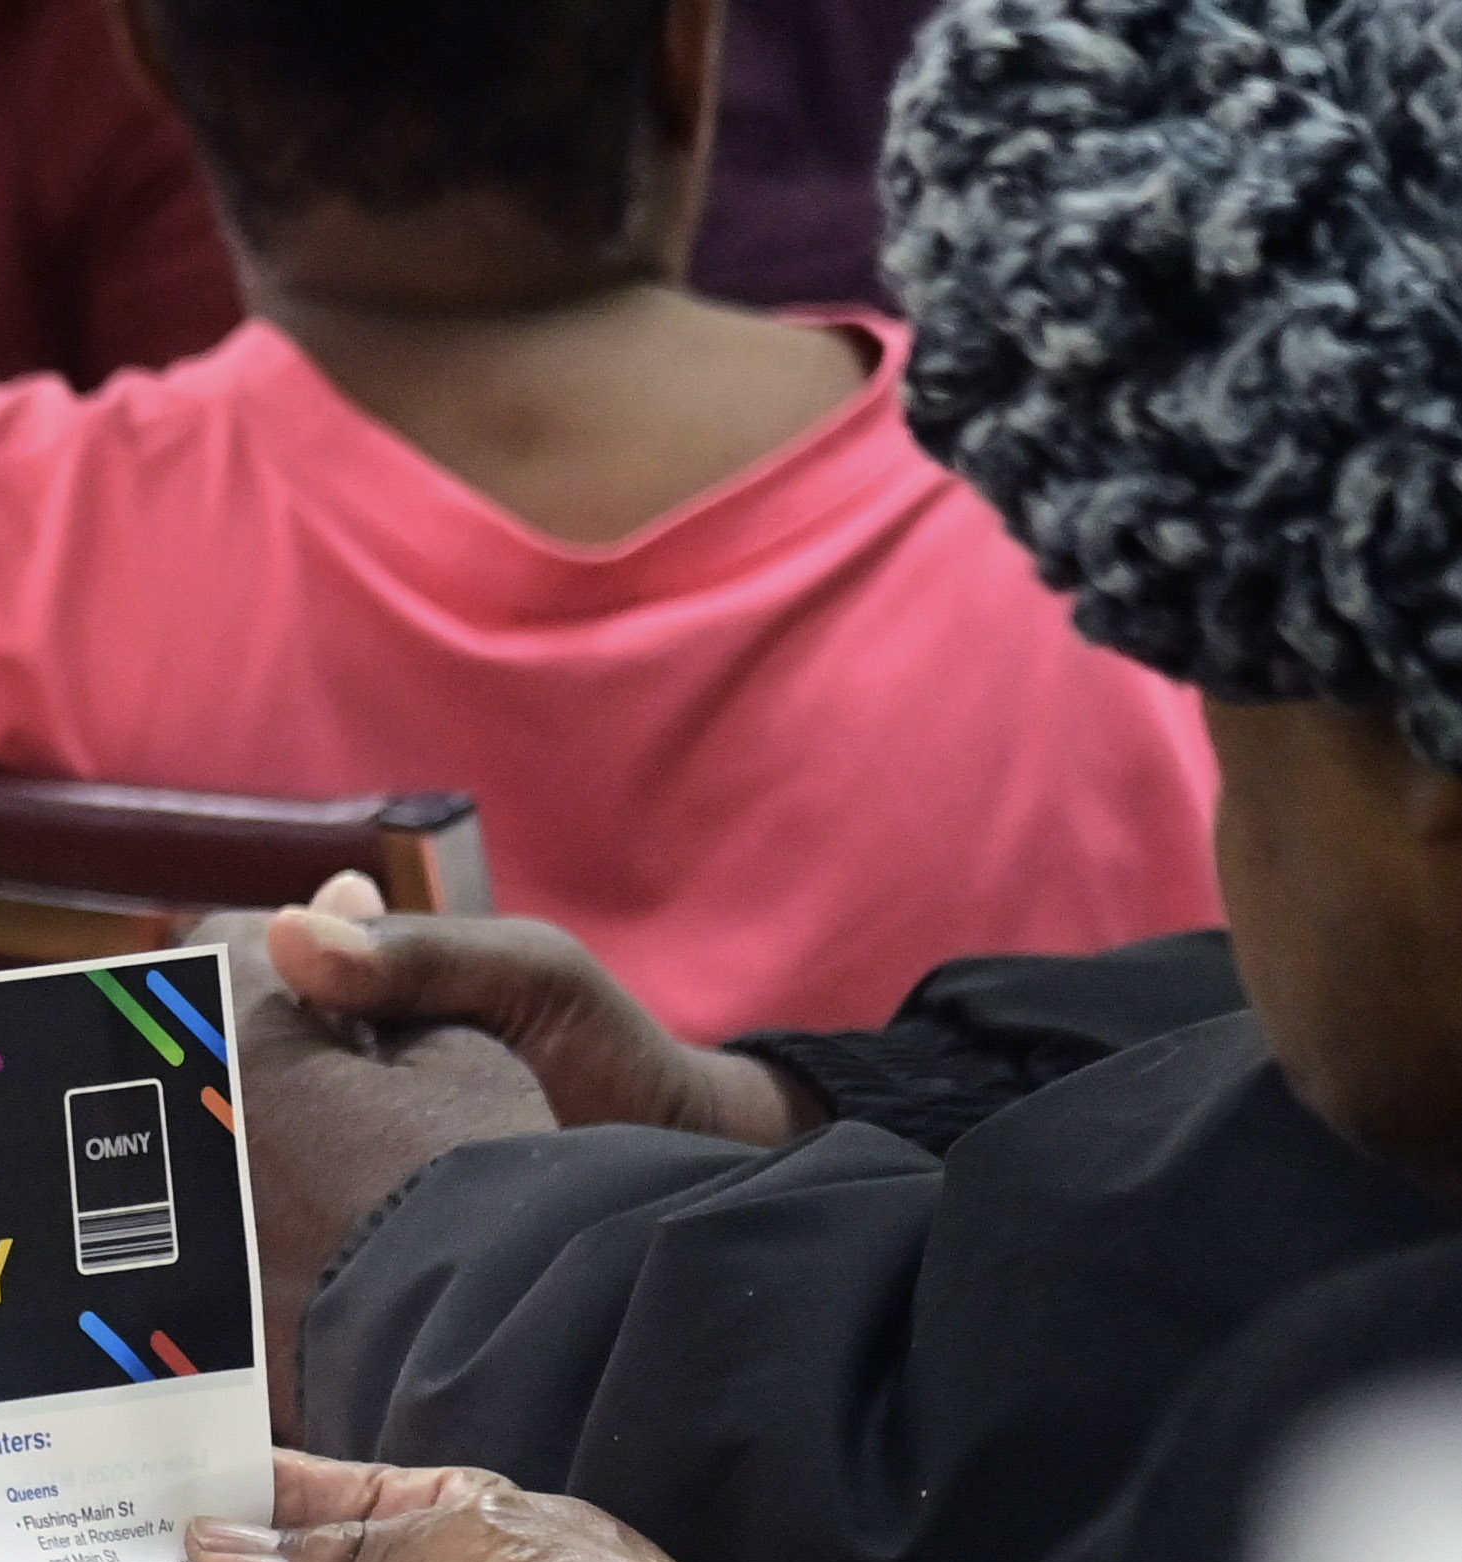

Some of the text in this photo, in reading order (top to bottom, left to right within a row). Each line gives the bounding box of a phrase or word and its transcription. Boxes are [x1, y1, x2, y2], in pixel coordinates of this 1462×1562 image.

[85, 1131, 152, 1162] OMNY
[6, 1484, 59, 1503] Queens
[23, 1501, 135, 1531] Flushing-Main St
[37, 1519, 175, 1551] Enter at Roosevelt Av
